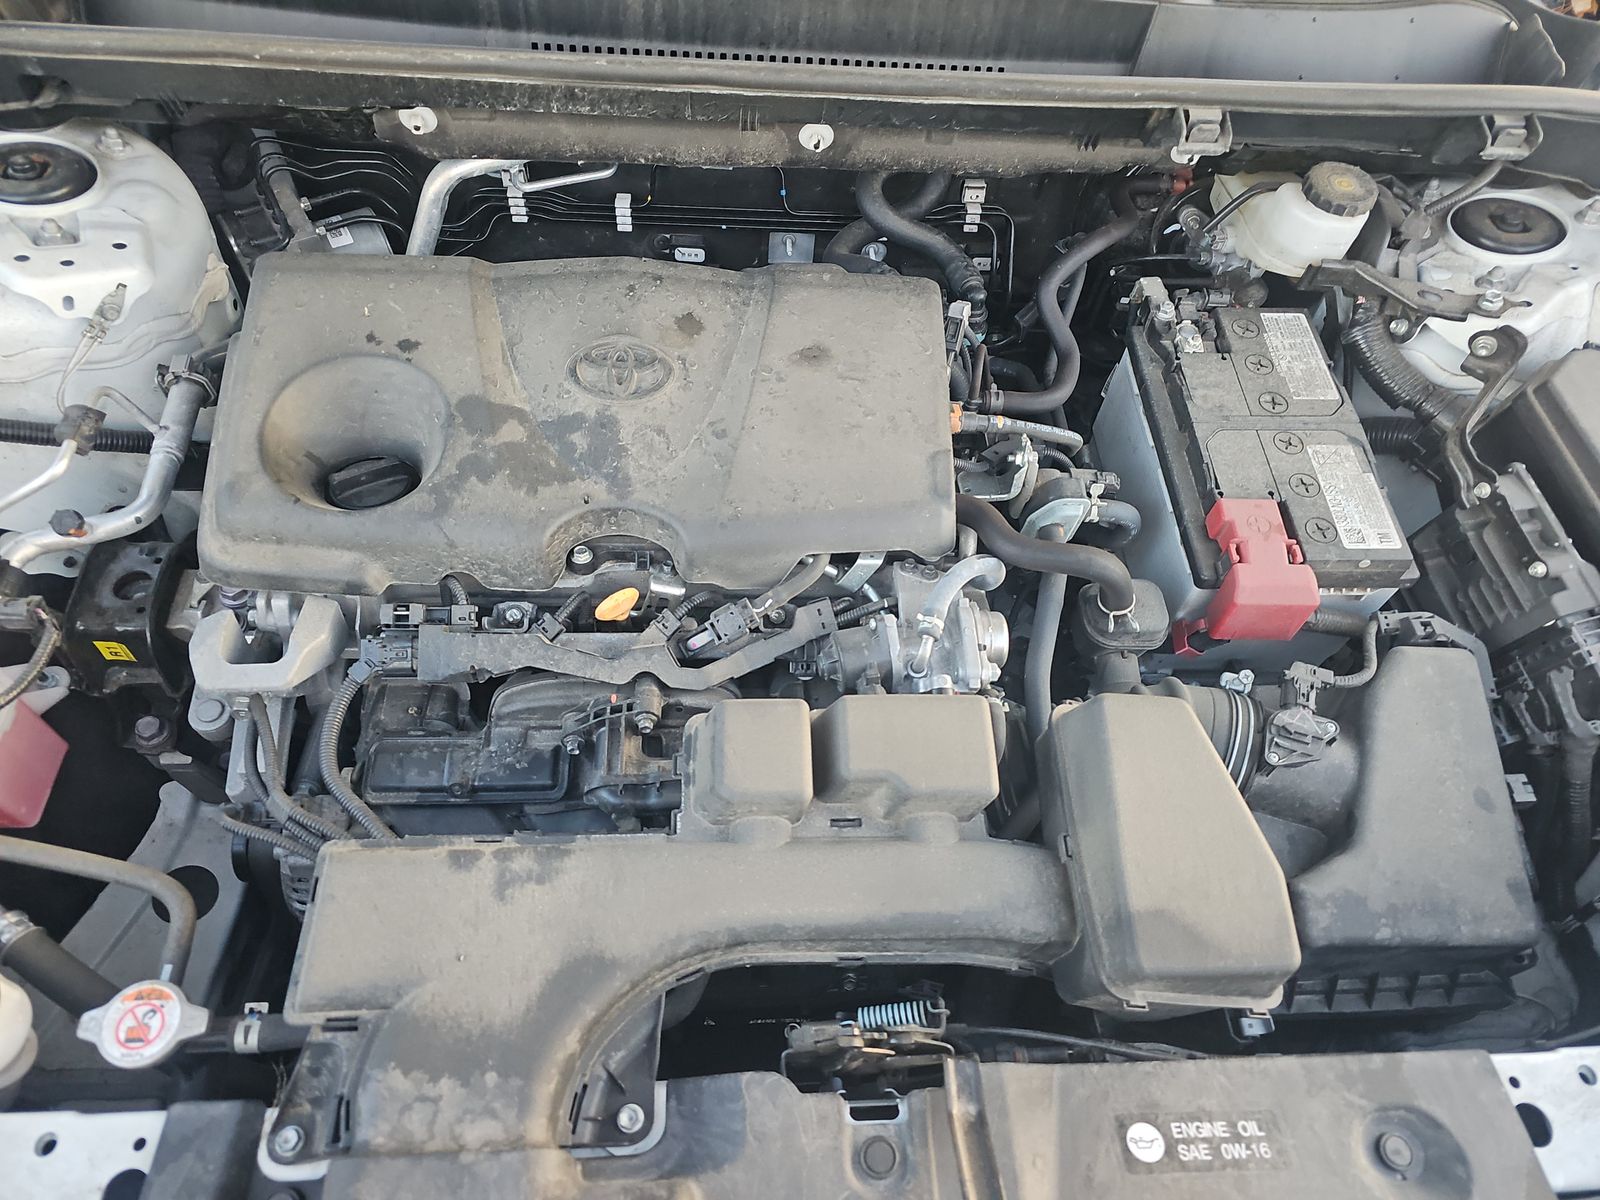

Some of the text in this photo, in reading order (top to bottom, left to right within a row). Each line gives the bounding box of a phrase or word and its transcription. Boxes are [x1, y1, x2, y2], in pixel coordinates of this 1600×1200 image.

[1170, 1120, 1266, 1139] ENGINE OIL
[1177, 1142, 1272, 1161] SAE 0W-16
